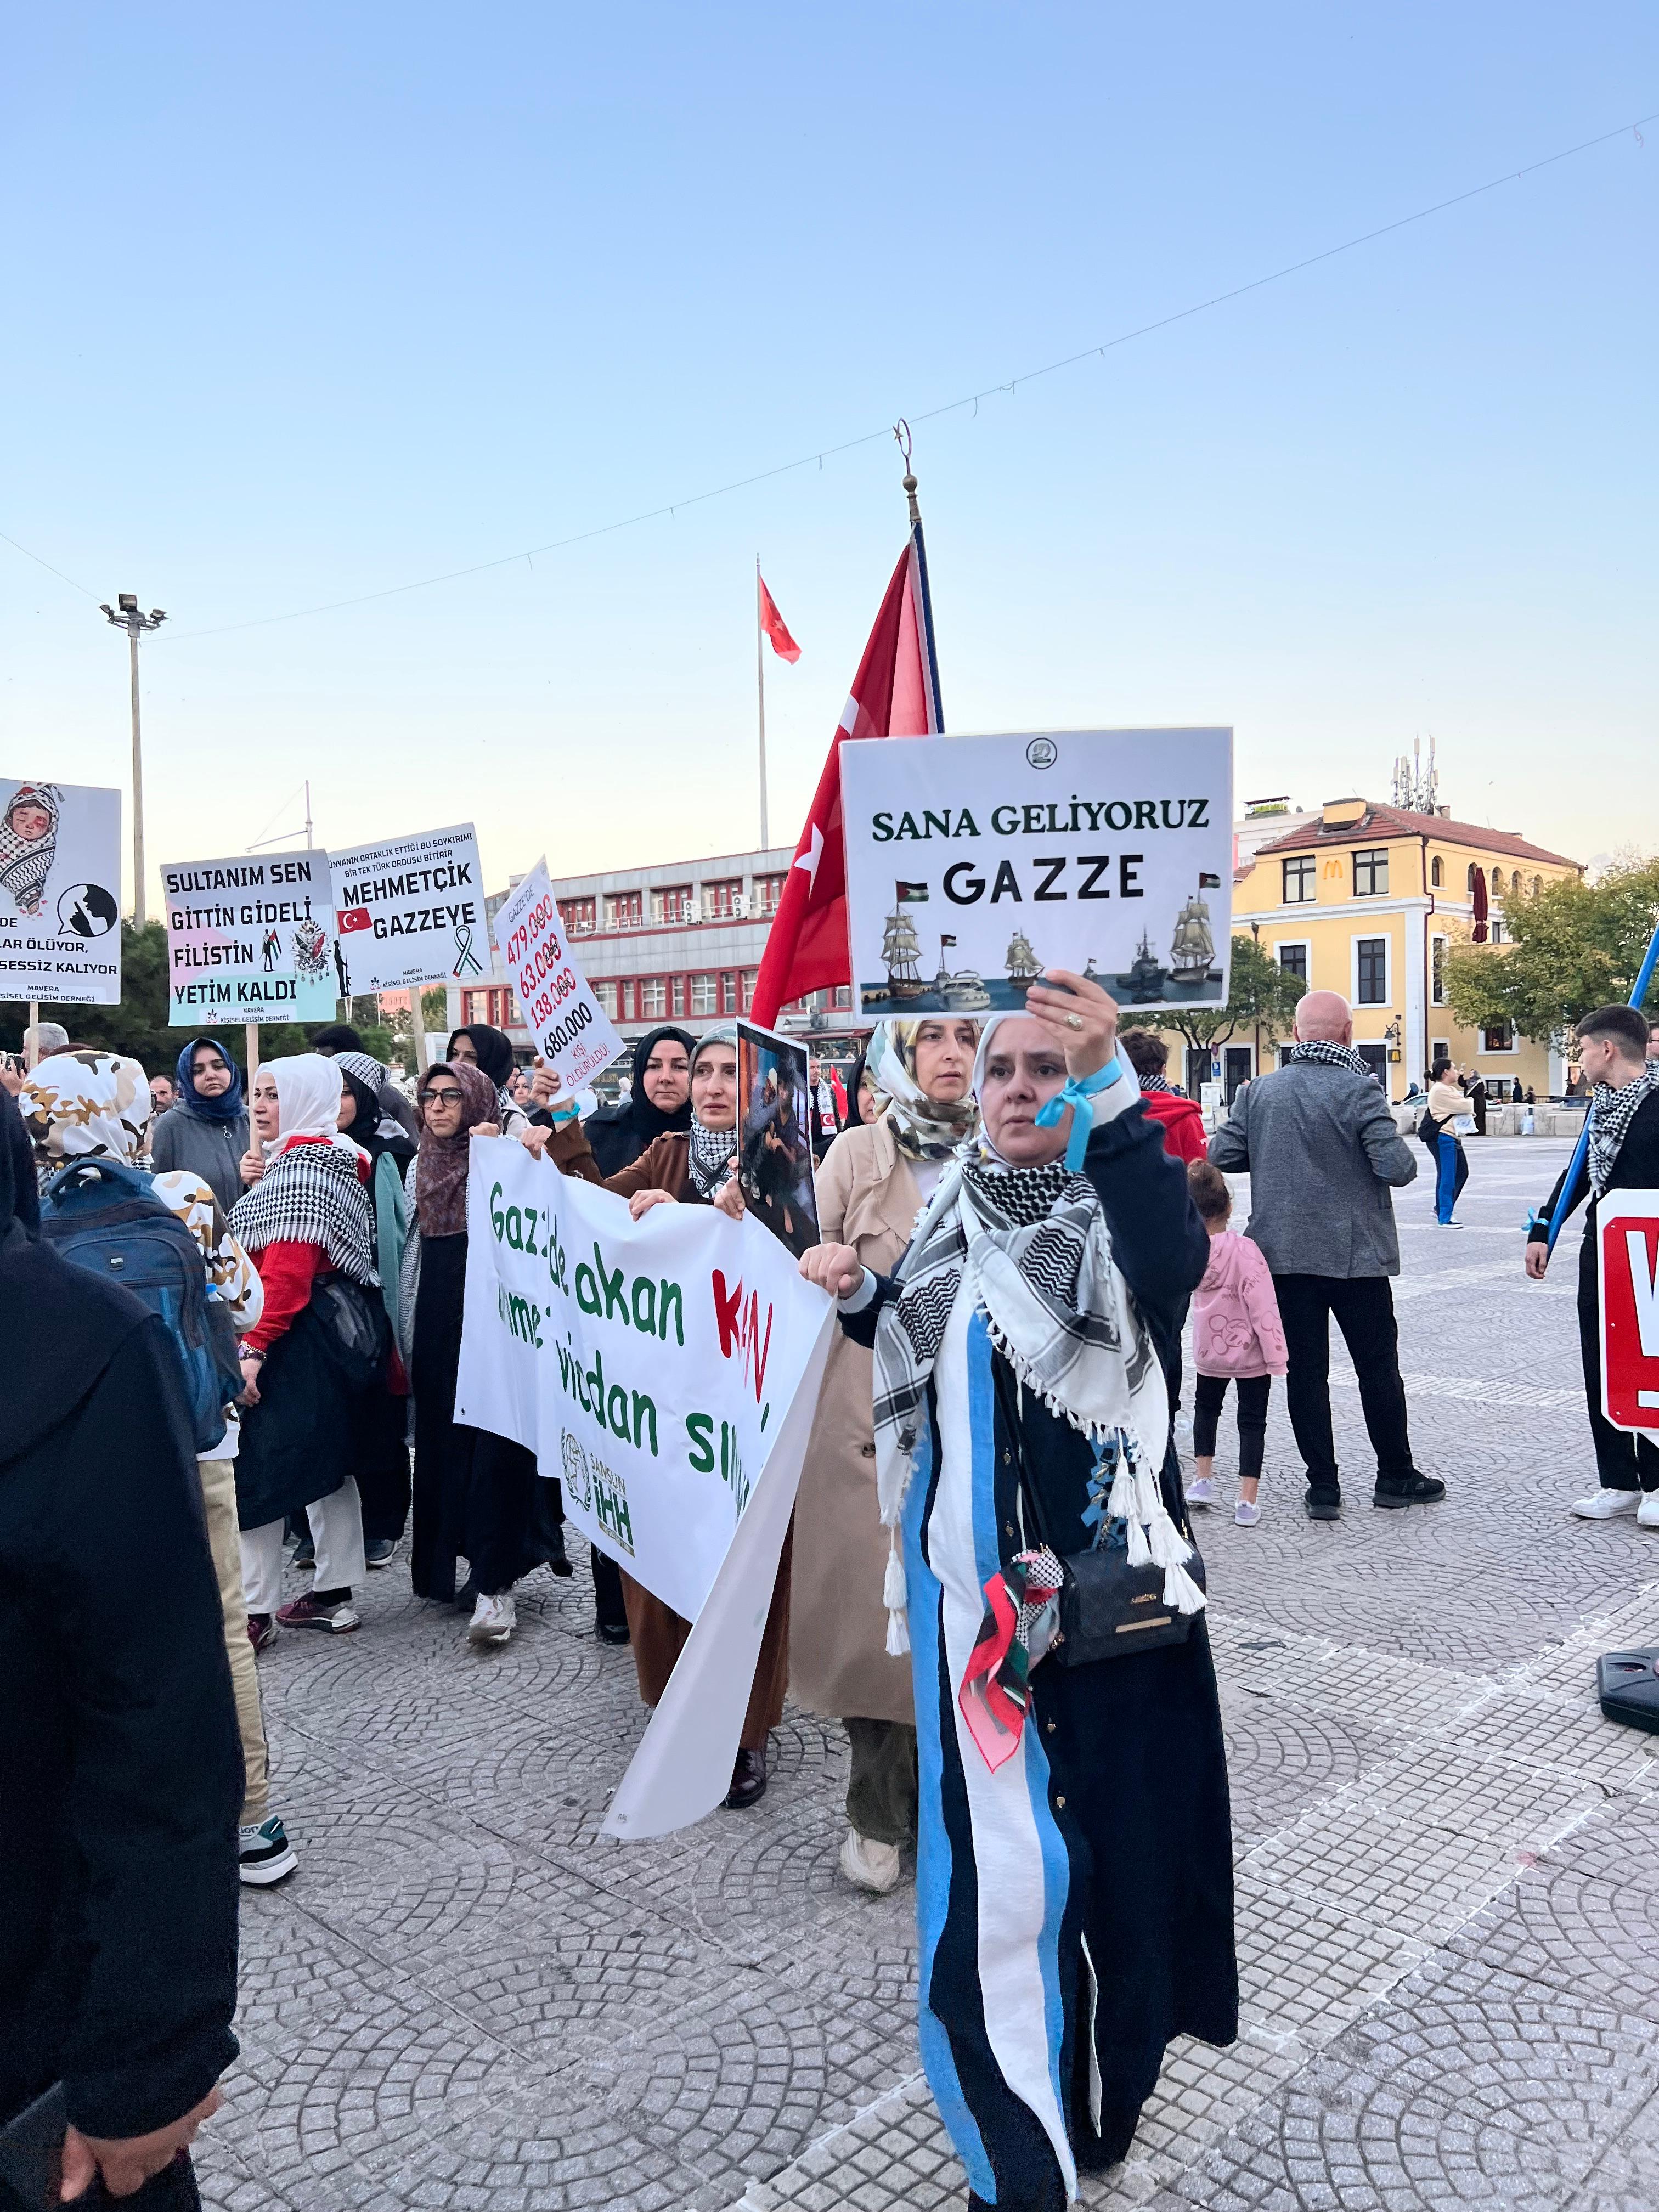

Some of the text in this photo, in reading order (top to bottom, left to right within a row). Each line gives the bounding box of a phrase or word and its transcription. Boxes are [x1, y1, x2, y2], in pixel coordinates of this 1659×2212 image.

[872, 794, 1210, 842] SANA GELİYORUZ
[329, 833, 473, 869] ÜNYANIN ORTAKLIK ETTİĞİ BU SOYKIRIMI
[345, 849, 453, 878] BİR TEK TÜRK ORDUSU BİTİRİR
[167, 861, 312, 893] SULTANIM SEN
[343, 860, 472, 907] MEHMETÇİK
[943, 854, 1144, 906] GAZZE
[171, 896, 312, 930] GİTTİN GİDELİ
[373, 902, 476, 939] GAZZEYE
[509, 885, 534, 923] GAZZE'DE
[27, 938, 88, 953] ÖLÜYOR,
[508, 894, 553, 965] 479.000
[0, 960, 117, 975] SESSİZ KALIYOR
[174, 940, 253, 968] FİLİSTİN
[520, 933, 561, 998] 63.000
[174, 979, 297, 1004] YETİM KALDI
[544, 1002, 592, 1059] 680.000
[574, 1242, 684, 1347] akan
[556, 1331, 658, 1457] vicdan
